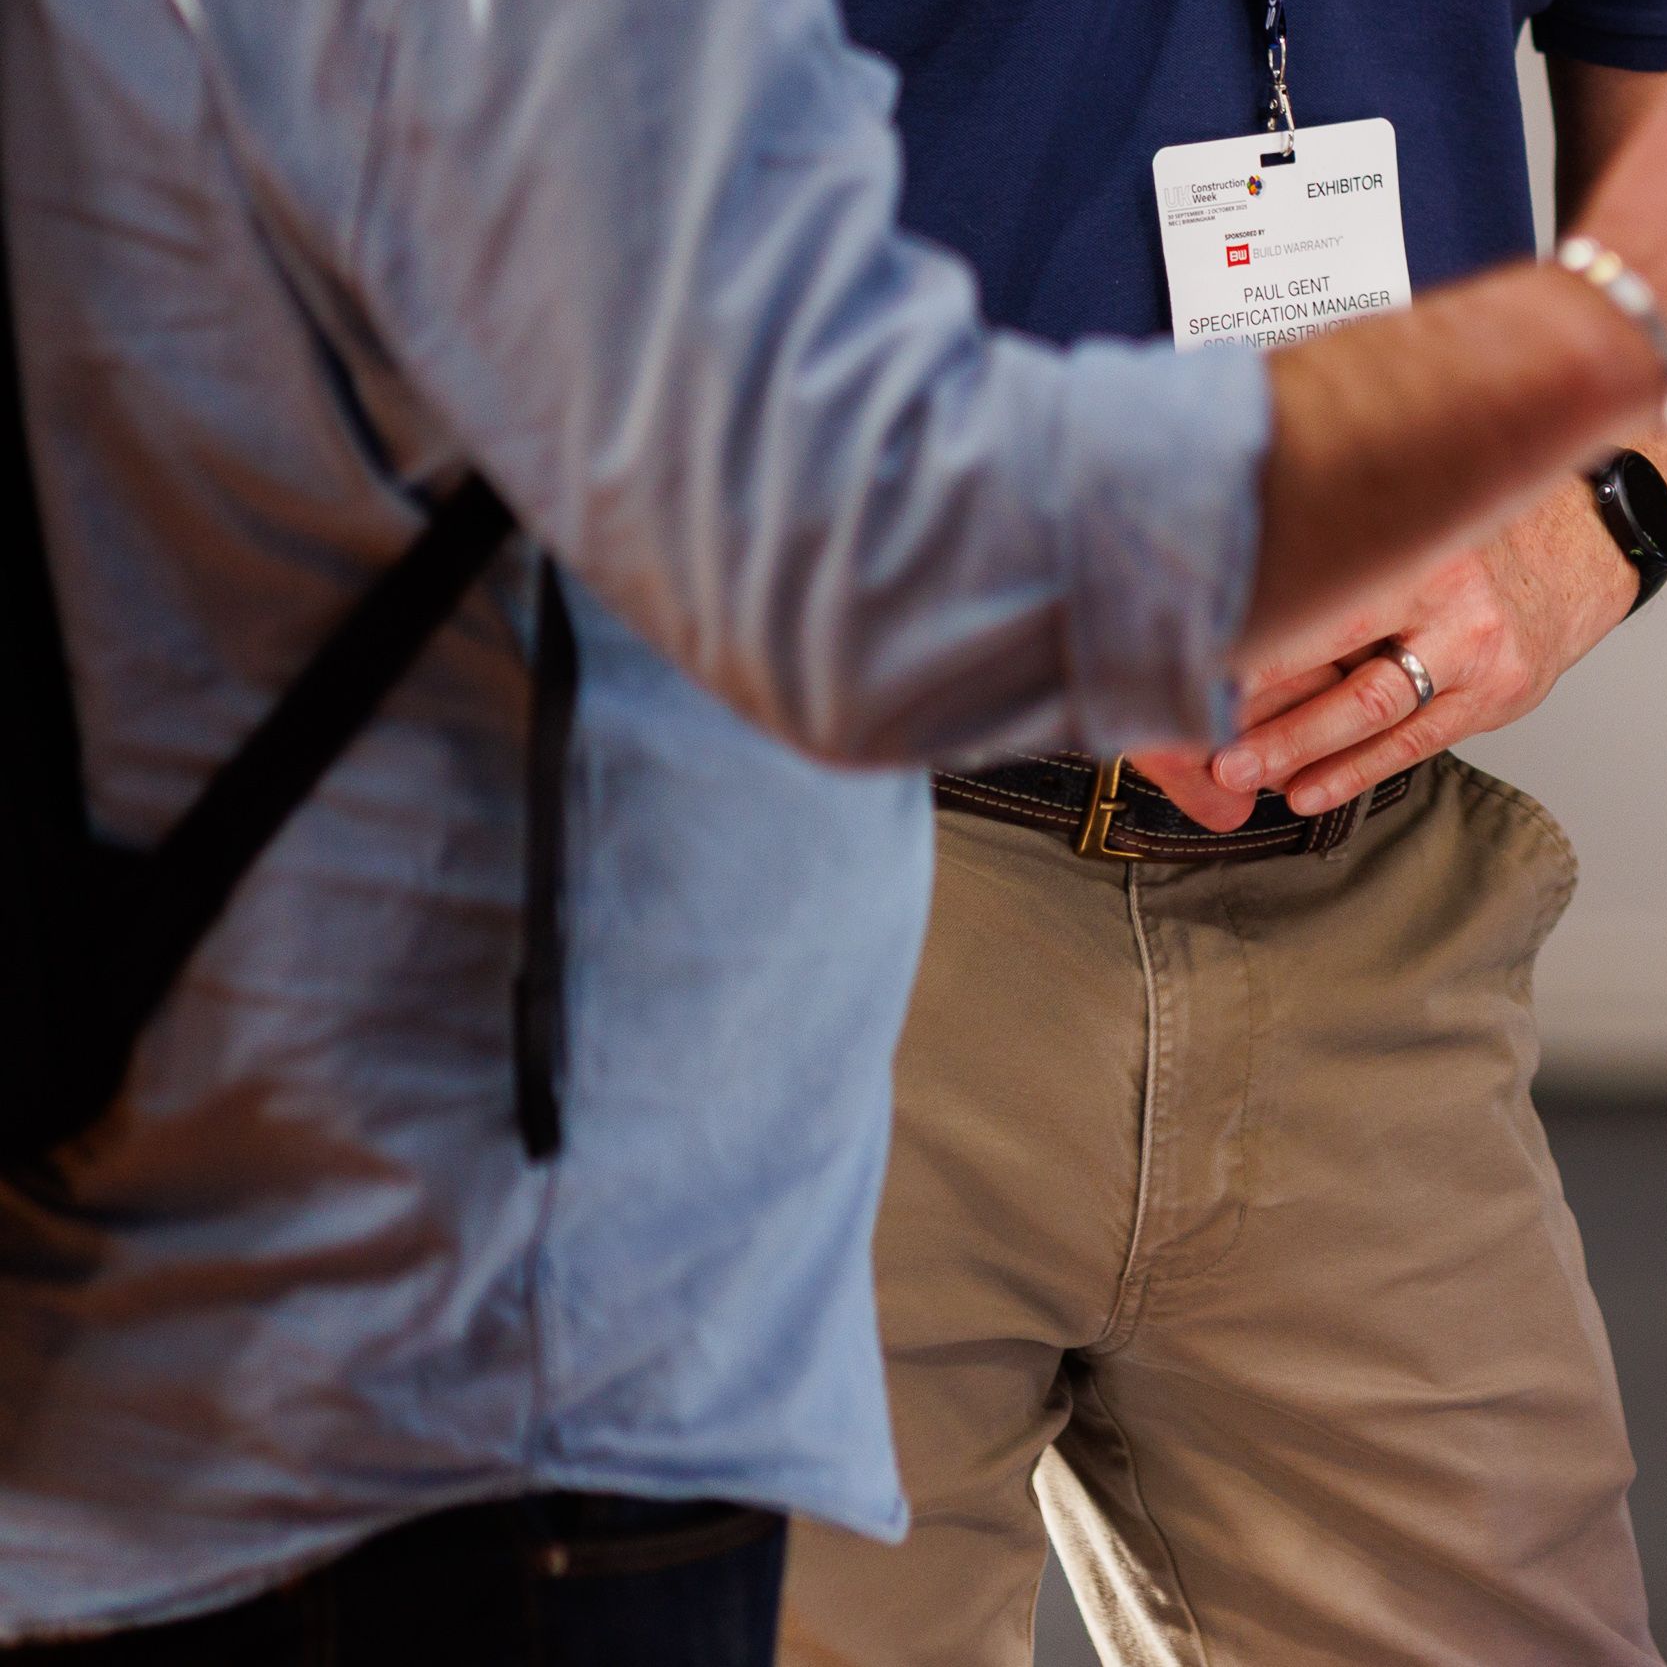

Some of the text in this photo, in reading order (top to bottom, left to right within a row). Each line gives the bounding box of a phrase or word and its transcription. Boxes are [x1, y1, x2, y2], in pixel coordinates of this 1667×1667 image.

[1191, 179, 1245, 193] Construction
[1306, 173, 1384, 199] EXHIBITOR
[1192, 193, 1217, 204] Week
[1174, 209, 1205, 219] SEPTEMBER
[1211, 205, 1235, 214] OCTOBER
[1182, 215, 1216, 225] BIRMINGHAM
[1224, 231, 1257, 240] SPONSORED
[1228, 249, 1248, 262] BW
[1252, 245, 1282, 259] BUILD
[1244, 276, 1331, 304] PAUL GENT
[1189, 290, 1391, 335] SPECIFICATION MANAGER
